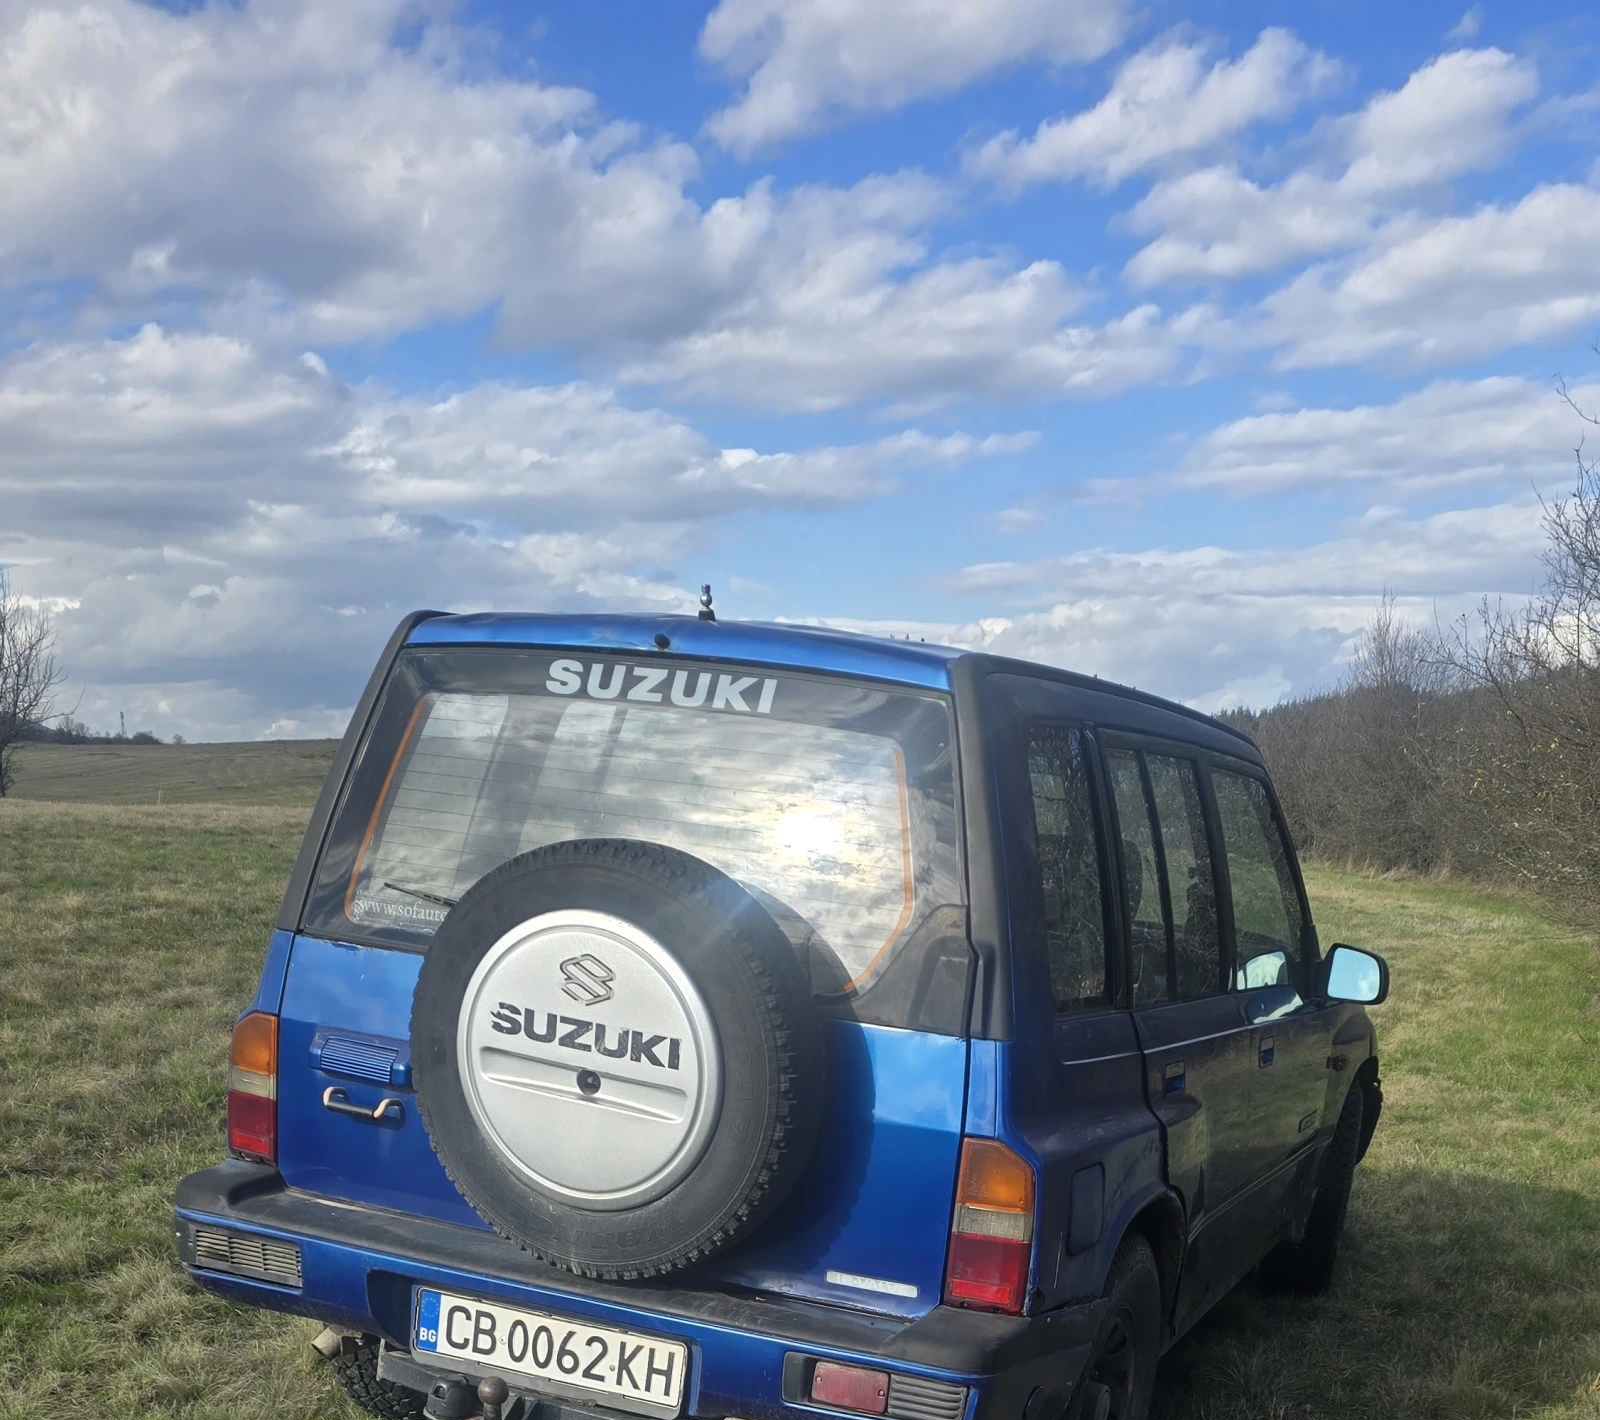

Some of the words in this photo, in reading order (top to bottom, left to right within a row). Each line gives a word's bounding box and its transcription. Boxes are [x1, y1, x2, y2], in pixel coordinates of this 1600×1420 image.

[545, 658, 778, 714] SUZUKI
[490, 1001, 682, 1071] SUZUKI
[419, 1326, 437, 1343] BG
[446, 1305, 497, 1355] CB
[507, 1319, 609, 1383] 0062
[615, 1340, 676, 1397] KH
